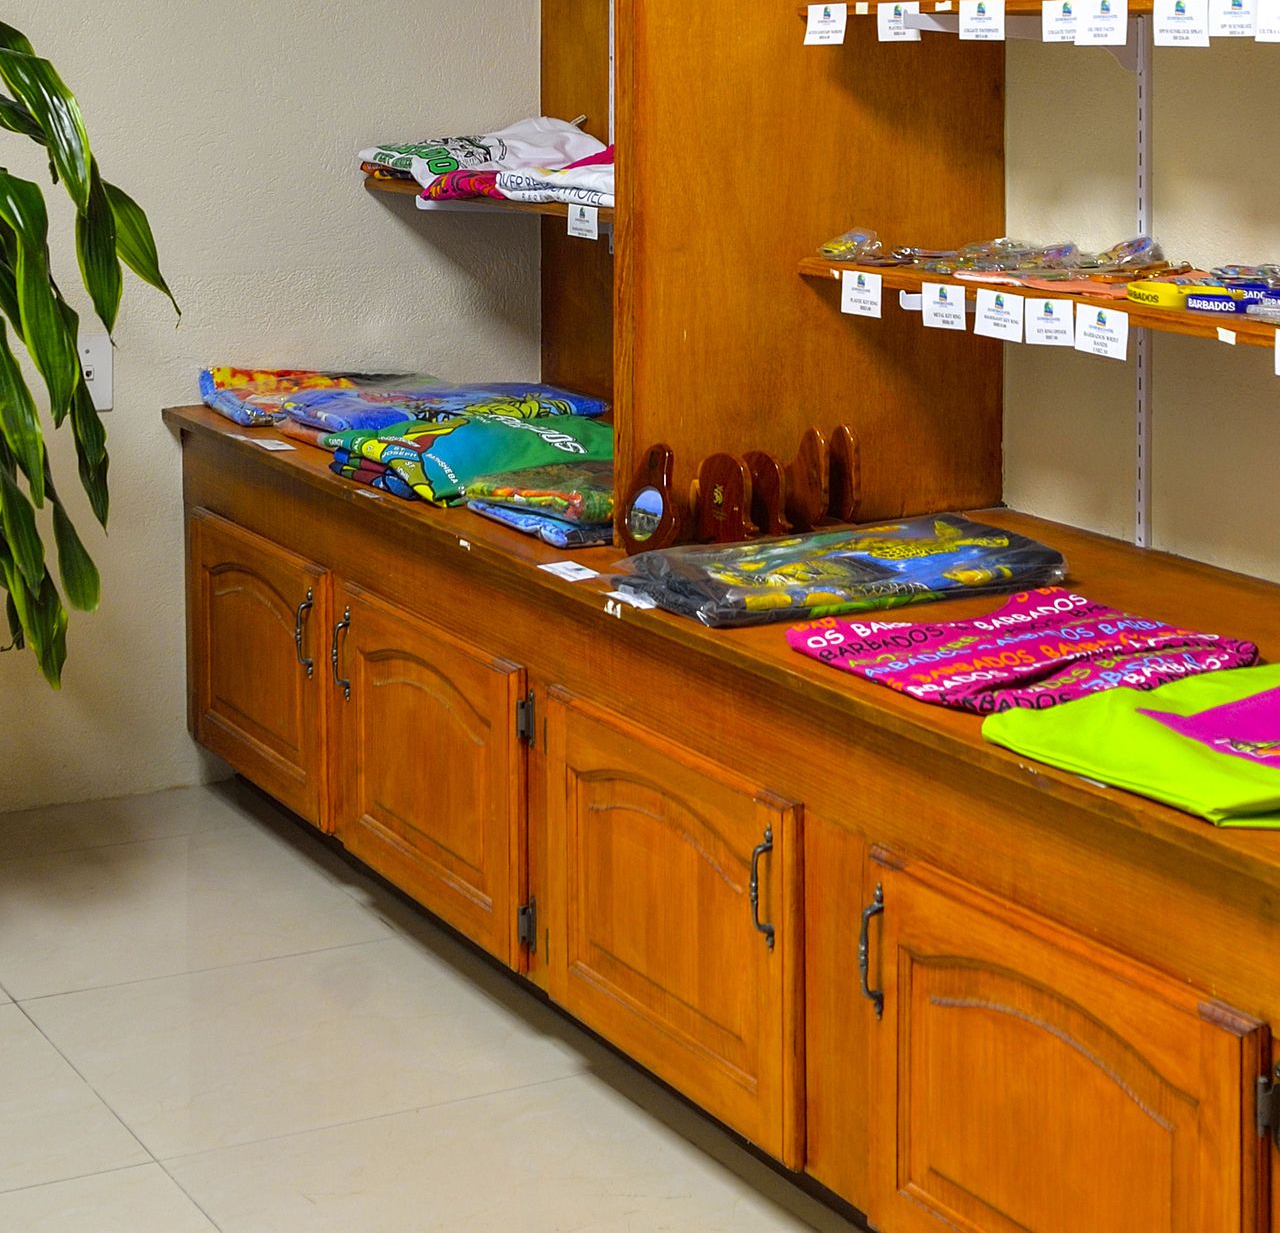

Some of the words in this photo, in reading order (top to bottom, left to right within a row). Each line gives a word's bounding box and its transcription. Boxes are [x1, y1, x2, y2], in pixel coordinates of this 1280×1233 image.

[568, 183, 604, 206] HOTEL
[1188, 298, 1236, 312] BARBADOS
[381, 448, 418, 459] JOSEPH
[426, 453, 458, 484] BATHSHEBA
[973, 593, 1088, 631] BARBADOS
[819, 624, 944, 662] BARBADOS
